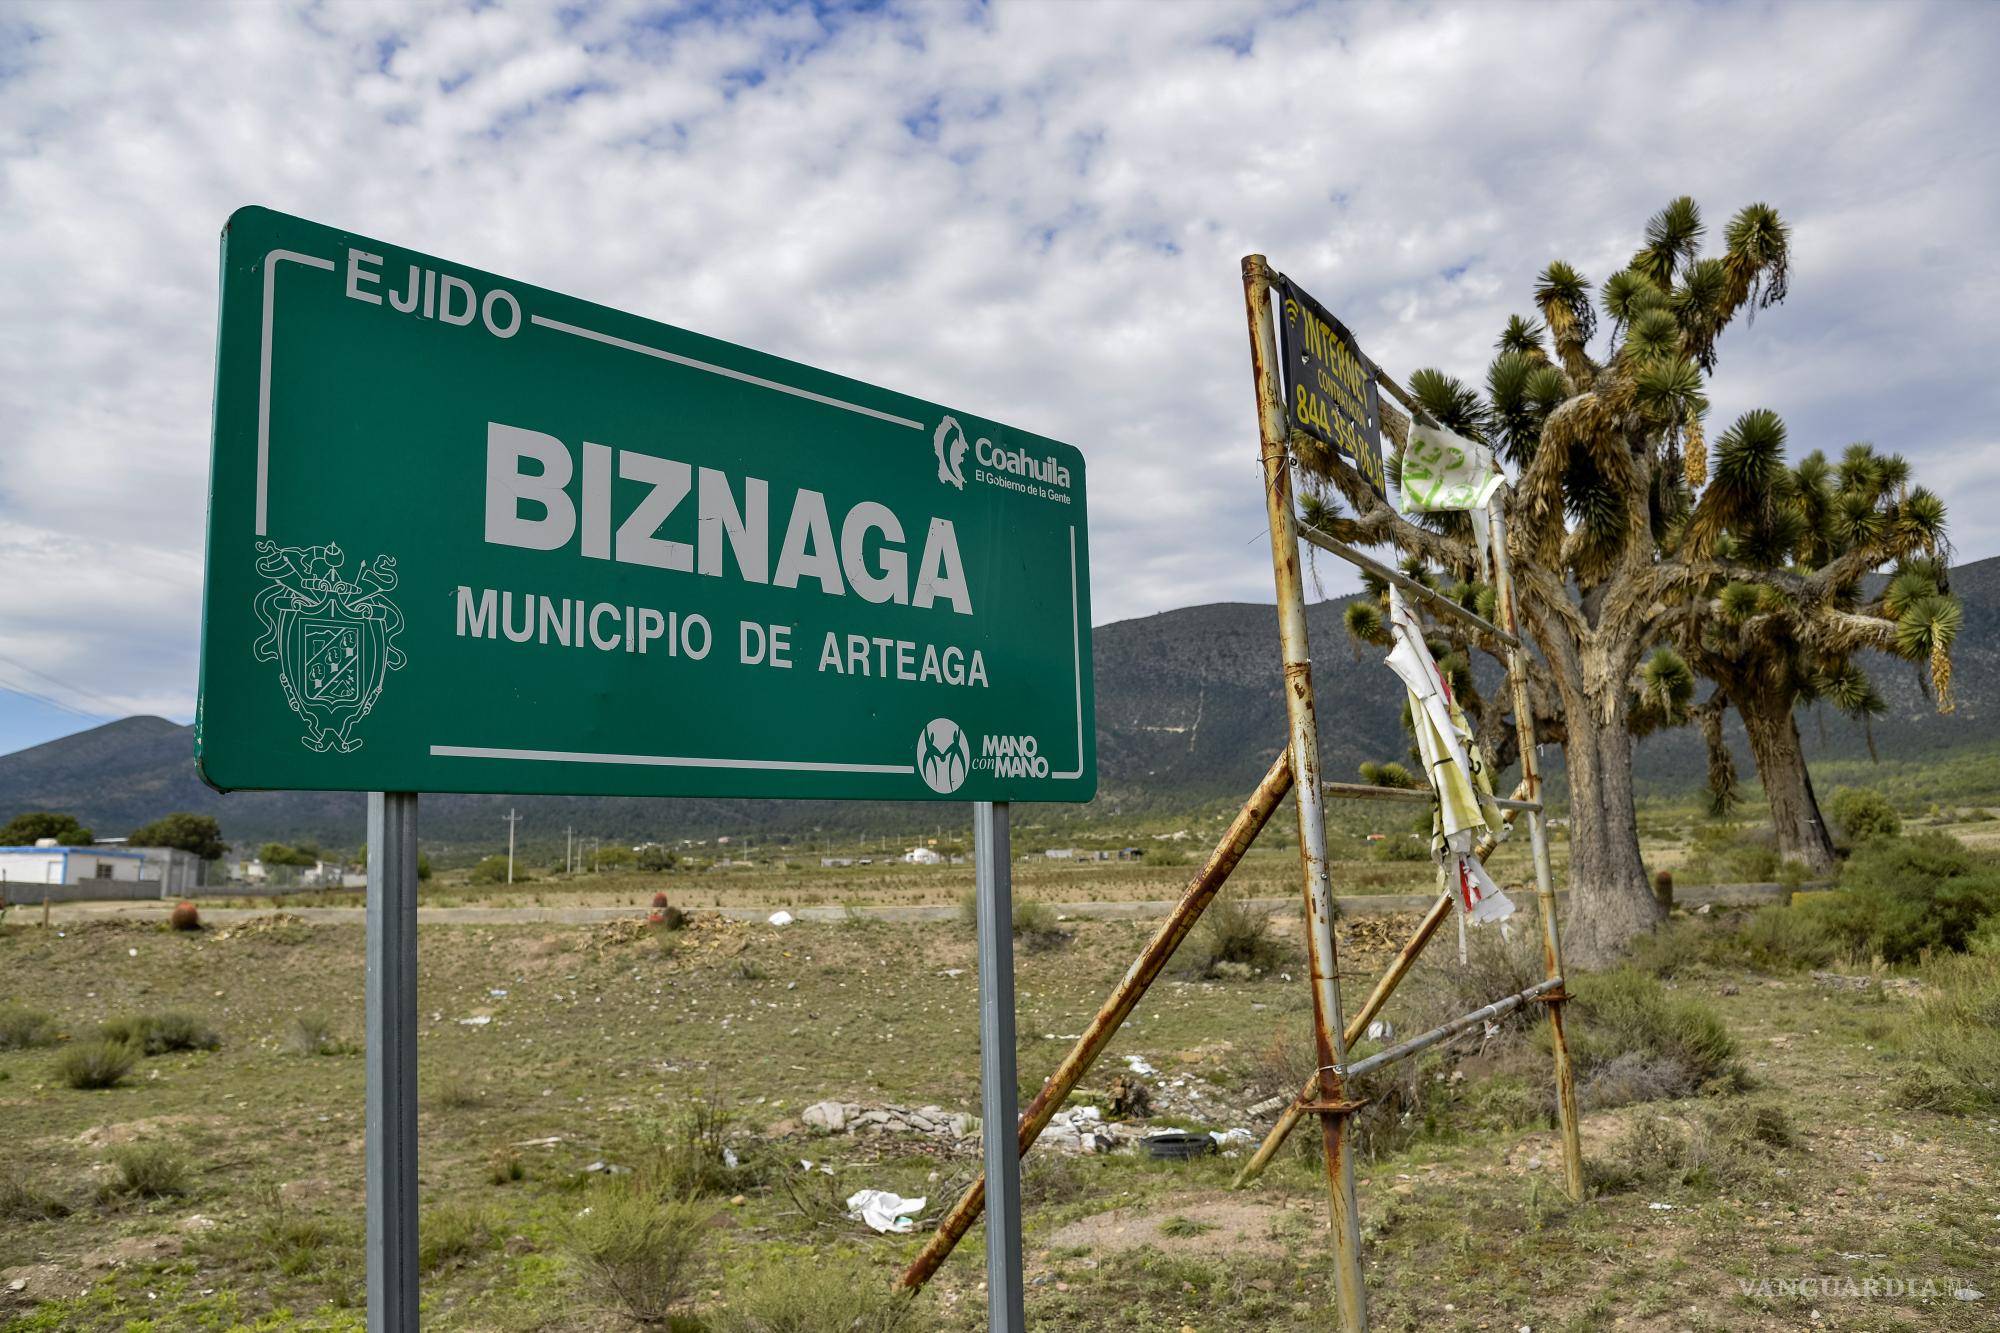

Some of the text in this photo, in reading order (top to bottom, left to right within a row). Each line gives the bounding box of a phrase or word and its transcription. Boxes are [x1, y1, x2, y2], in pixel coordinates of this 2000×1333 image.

[346, 248, 521, 338] EJIDO
[1302, 306, 1369, 410] INTERNET
[1296, 383, 1332, 439] 844
[975, 437, 1071, 488] Coahuila
[975, 469, 1071, 505] El Gobierno de la Gente
[485, 422, 973, 615] BIZNAGA
[456, 586, 989, 688] MUNICIPIO DE ARTEAGA
[971, 756, 1049, 778] con MANO
[982, 735, 1038, 757] MANO
